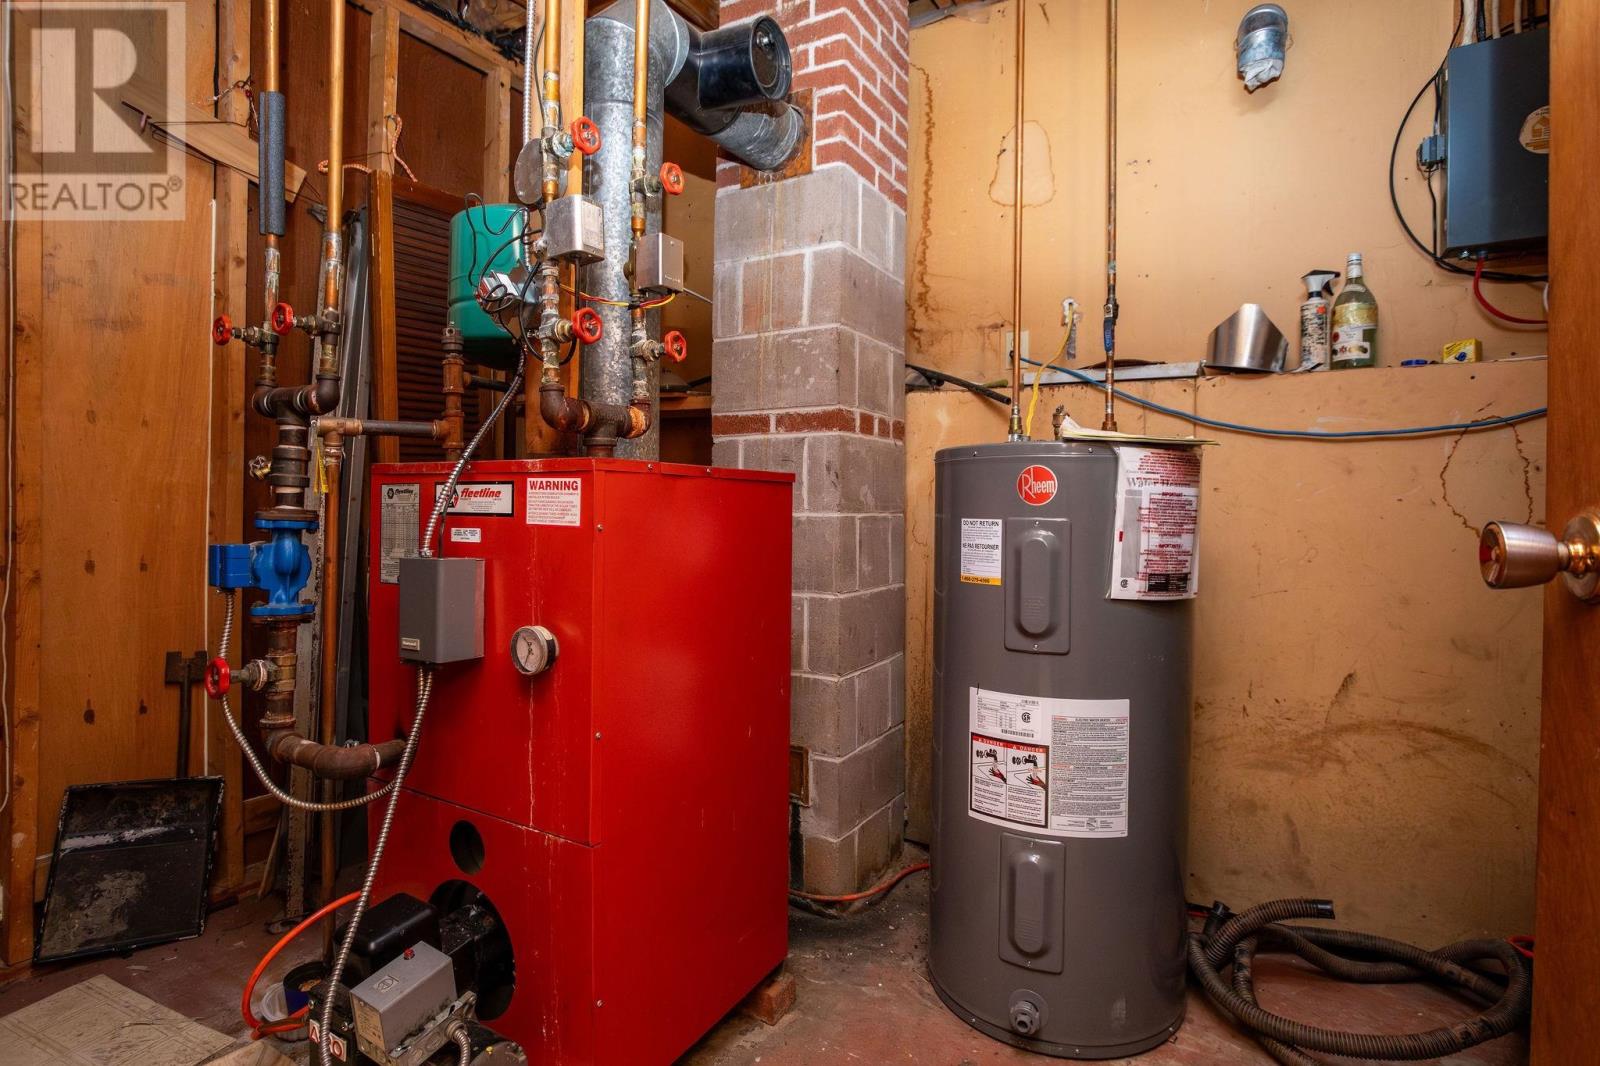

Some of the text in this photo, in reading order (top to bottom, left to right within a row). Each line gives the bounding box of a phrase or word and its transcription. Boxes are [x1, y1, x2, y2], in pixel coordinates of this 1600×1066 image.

[529, 480, 579, 491] WARNING
[1021, 467, 1055, 499] Rheem
[461, 487, 502, 498] fleetline
[1020, 745, 1043, 753] DANGER
